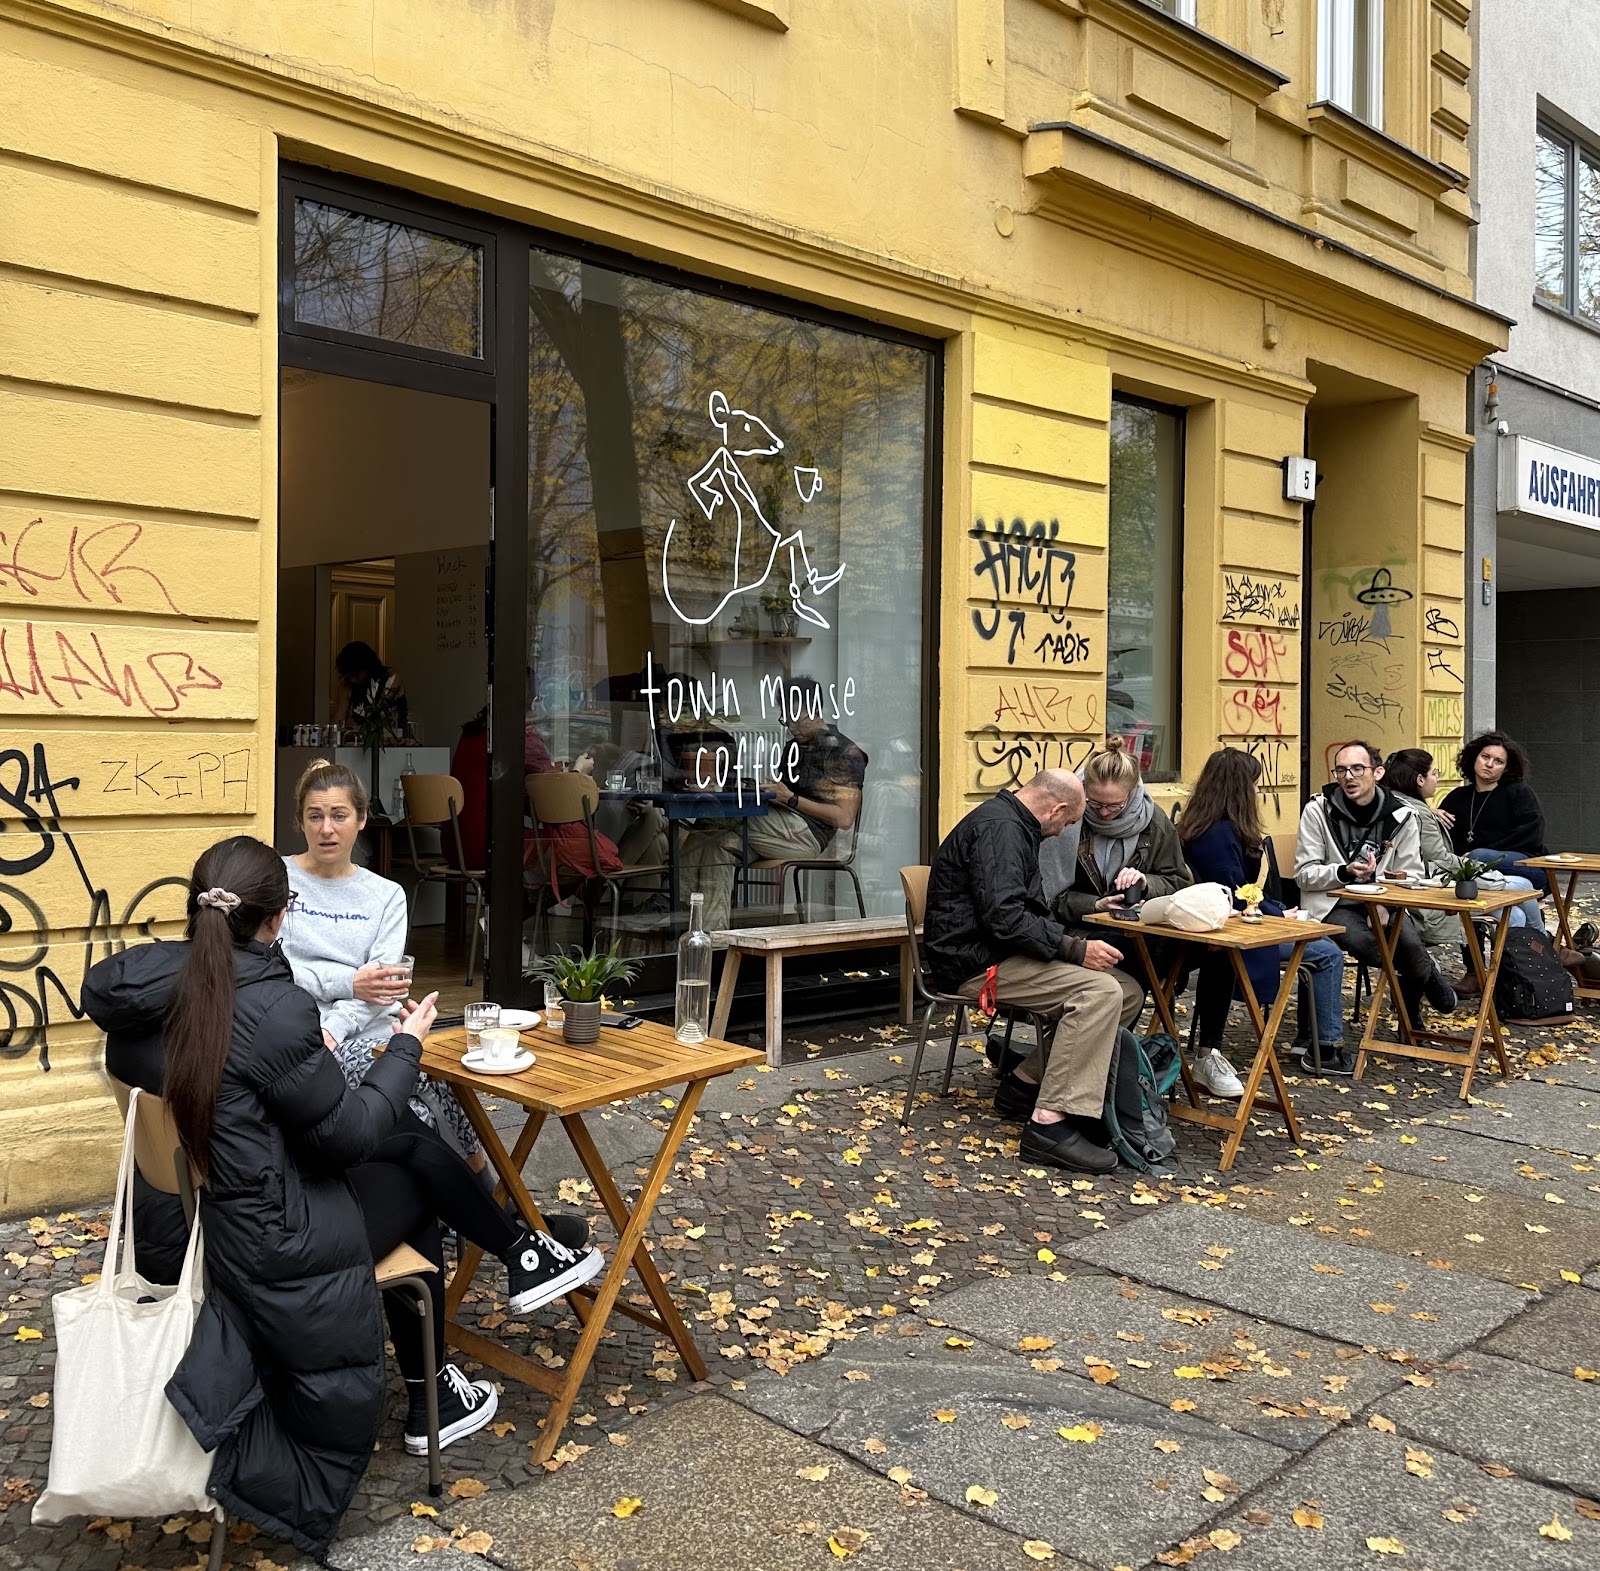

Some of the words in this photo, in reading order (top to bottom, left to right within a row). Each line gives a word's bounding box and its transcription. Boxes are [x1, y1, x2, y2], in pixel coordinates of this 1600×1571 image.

[1304, 470, 1310, 490] 5
[640, 651, 741, 730] town
[760, 673, 856, 723] mouse
[695, 736, 800, 809] coffee
